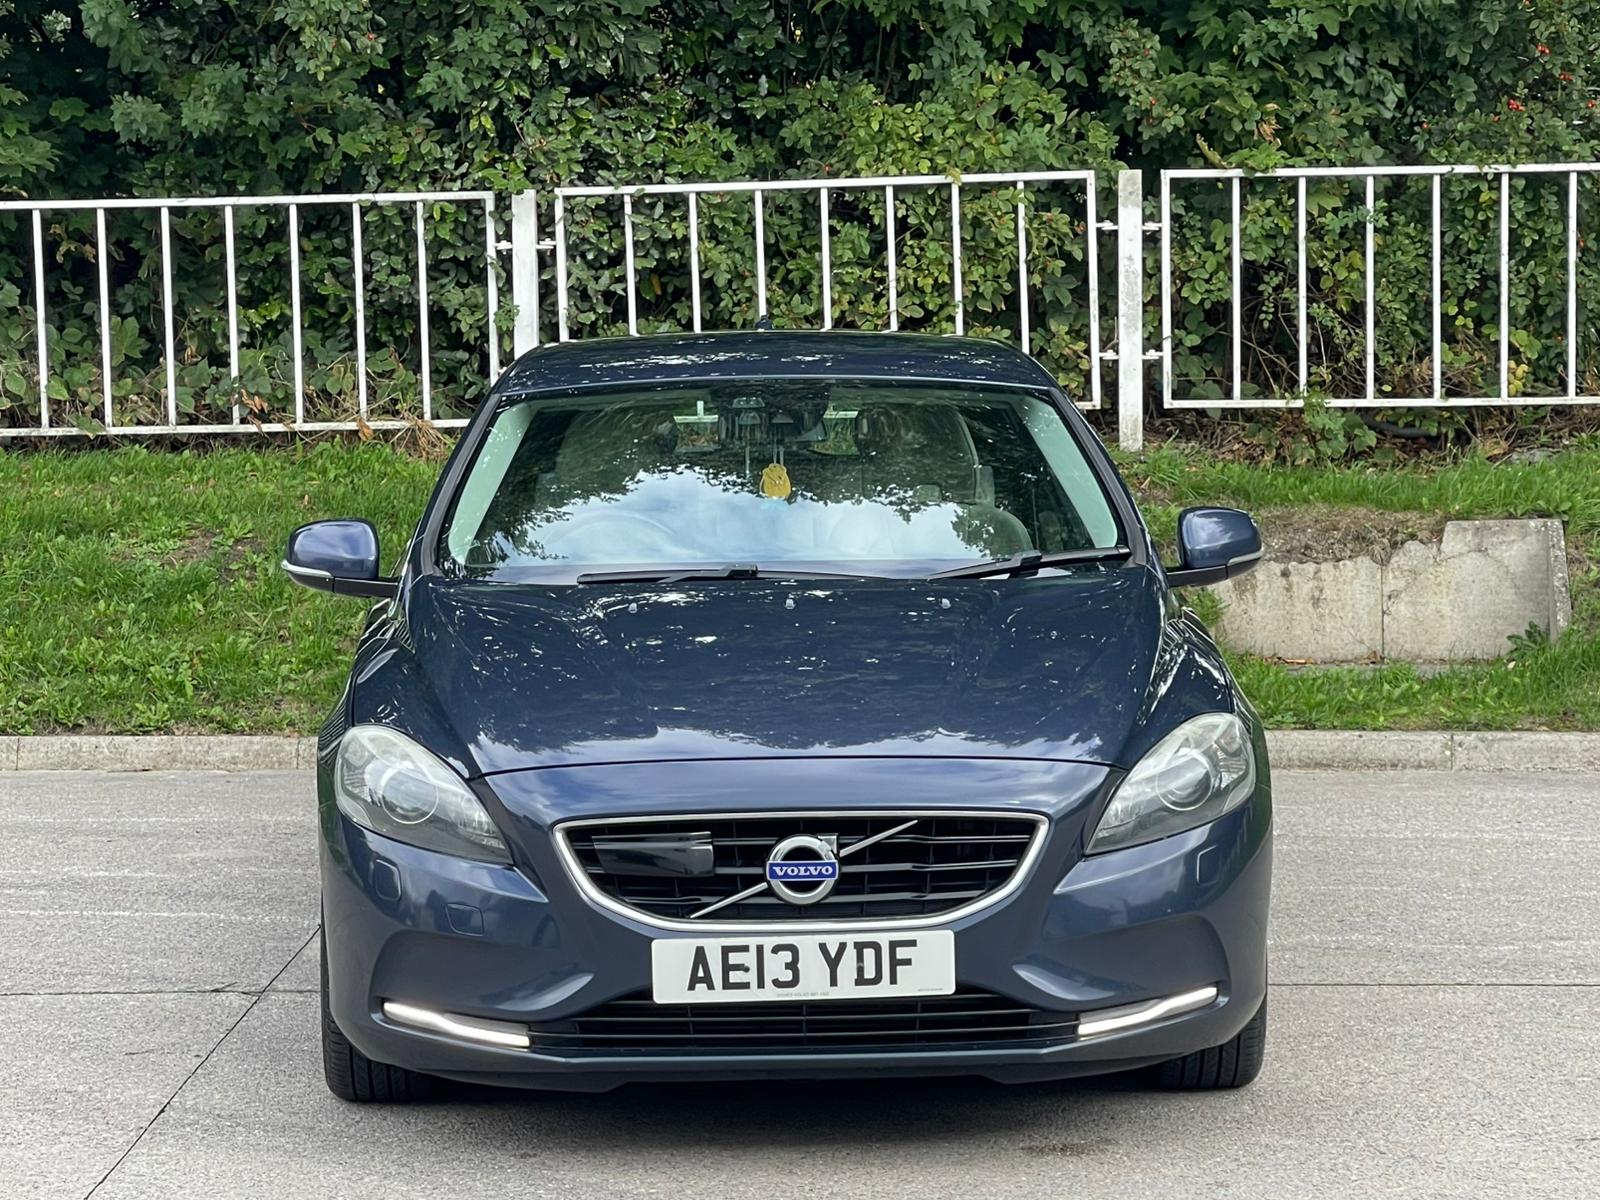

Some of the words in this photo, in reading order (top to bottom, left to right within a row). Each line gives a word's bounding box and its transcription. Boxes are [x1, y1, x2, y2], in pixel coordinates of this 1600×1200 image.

[773, 865, 833, 876] VOLVO
[687, 943, 800, 991] AE13
[818, 939, 918, 987] YDF
